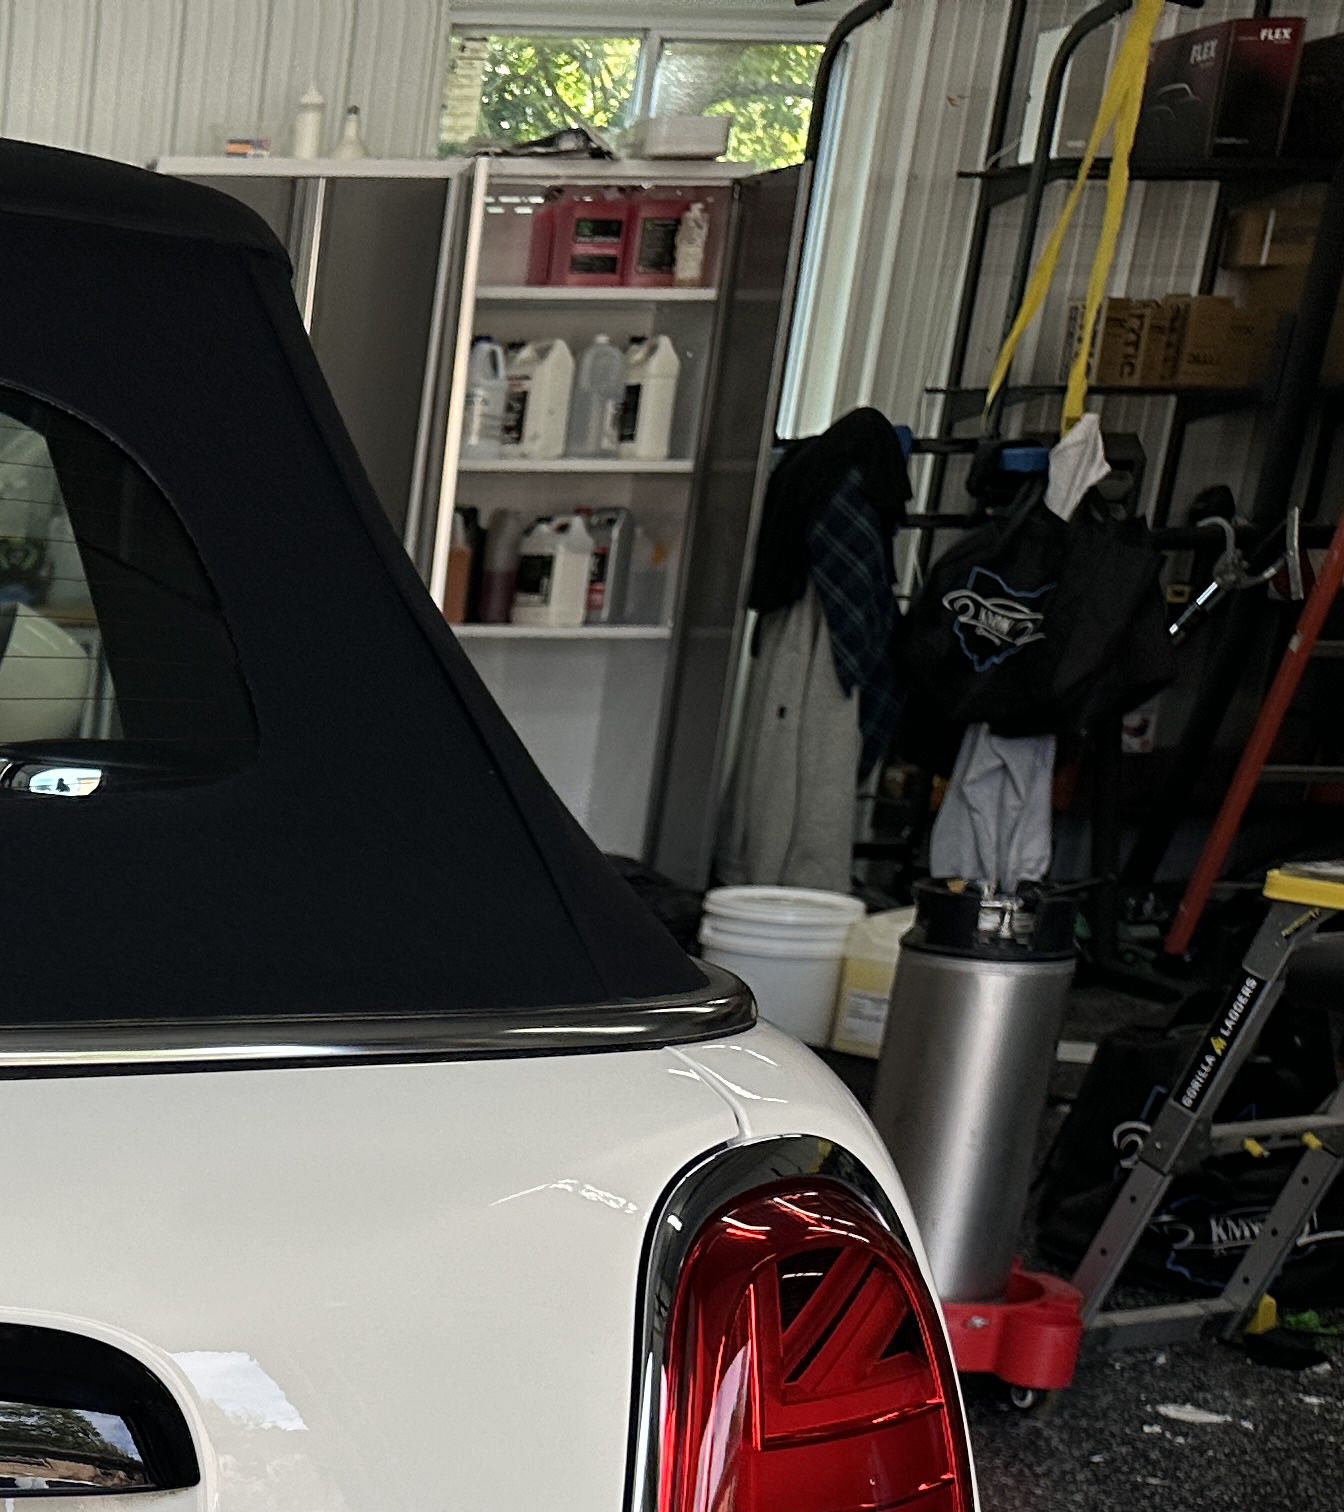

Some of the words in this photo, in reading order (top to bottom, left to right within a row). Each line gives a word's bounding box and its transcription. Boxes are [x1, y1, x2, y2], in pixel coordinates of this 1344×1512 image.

[1259, 27, 1293, 41] FLEX
[1189, 38, 1219, 65] FLEX
[1181, 1053, 1217, 1108] GORILLA
[1219, 976, 1258, 1037] LADDERS
